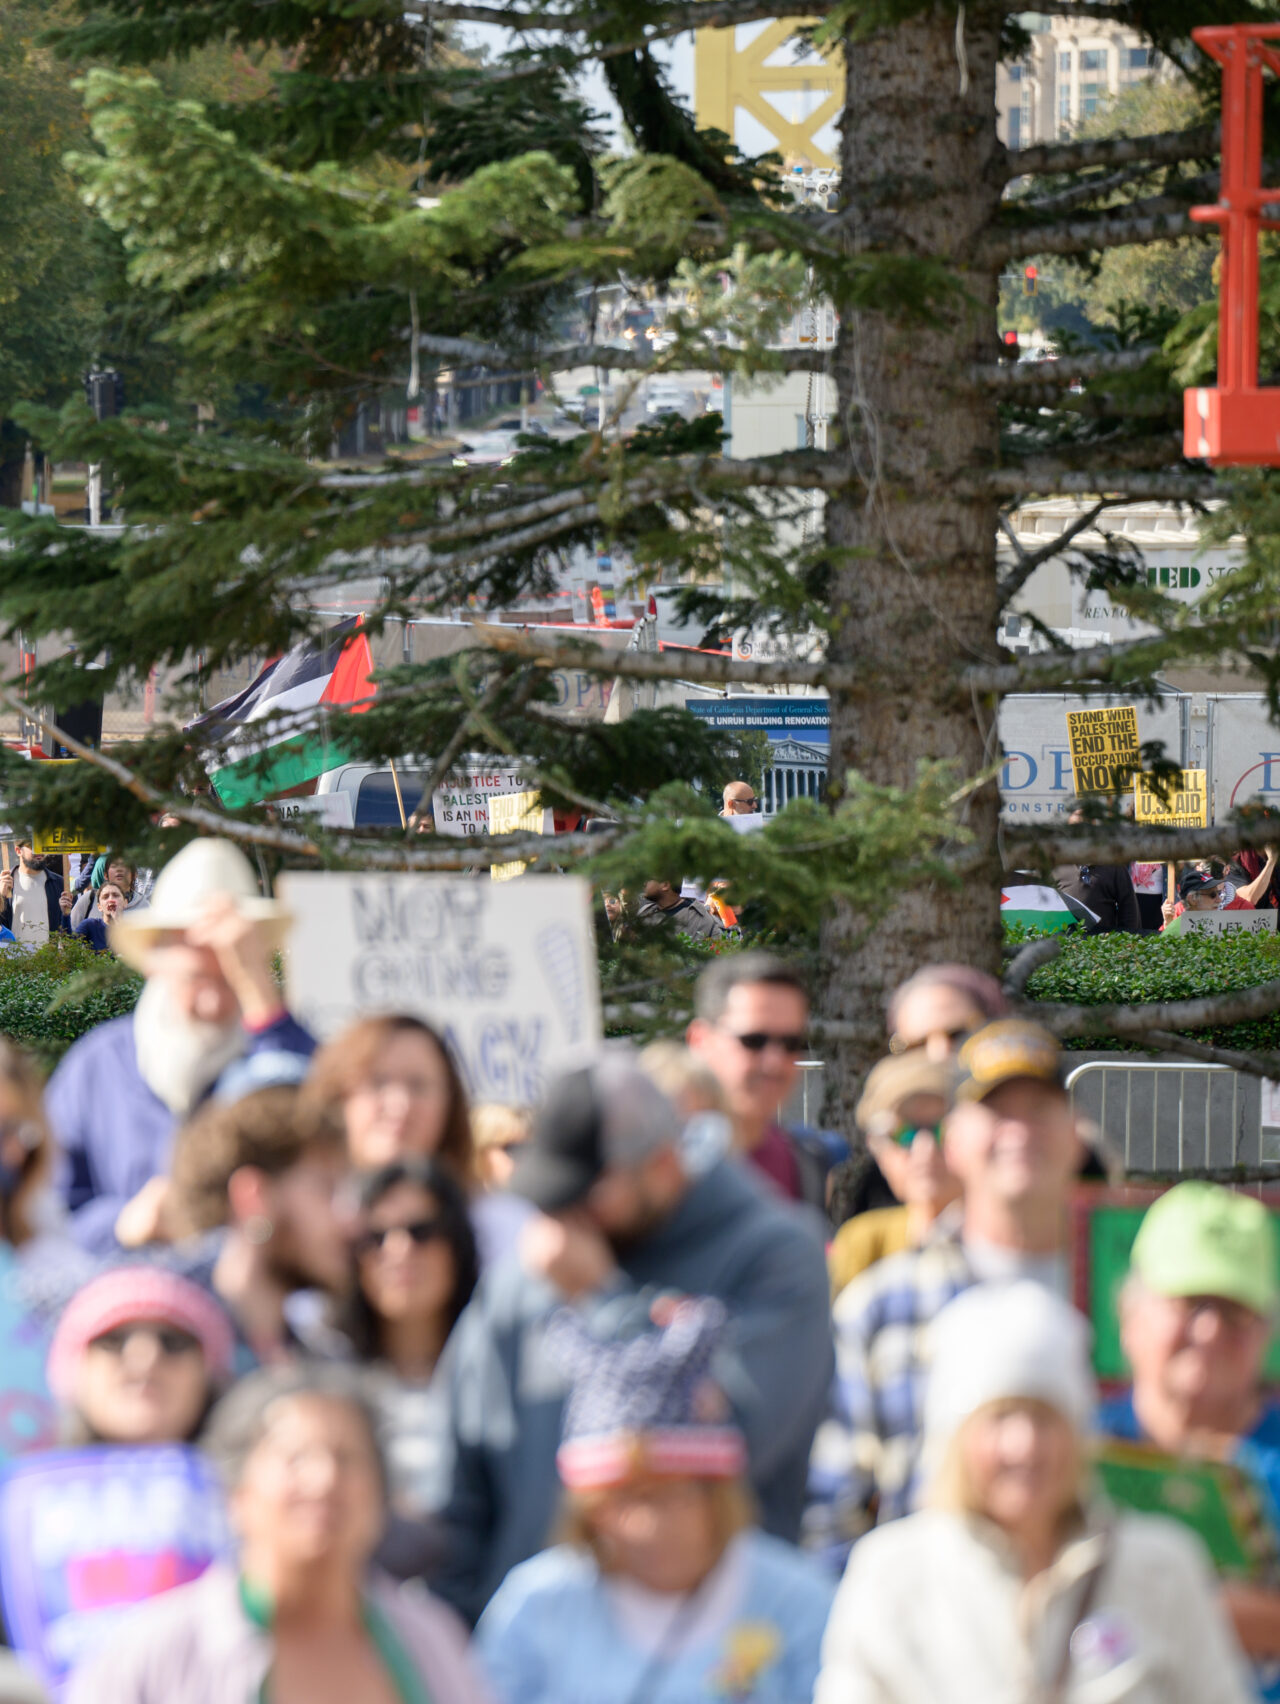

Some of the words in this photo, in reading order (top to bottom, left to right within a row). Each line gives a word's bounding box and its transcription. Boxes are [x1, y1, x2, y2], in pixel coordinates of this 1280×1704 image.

[707, 705, 713, 713] of
[714, 705, 744, 714] California
[745, 705, 780, 715] Department
[782, 705, 788, 713] of
[789, 705, 812, 713] General
[1069, 711, 1104, 725] STAND
[1106, 707, 1135, 721] WITH
[717, 716, 744, 725] UNRUH
[746, 716, 783, 725] BUILDING
[1071, 721, 1136, 738] PALESTINE!
[1072, 736, 1105, 755] END
[1107, 733, 1138, 752] THE
[1074, 752, 1140, 768] OCCUPATION
[999, 751, 1074, 790] DP
[507, 775, 523, 786] TO
[1176, 793, 1201, 813] AID
[443, 811, 453, 822] IS
[456, 810, 471, 822] AN
[462, 824, 476, 834] TO
[1219, 922, 1242, 932] LET
